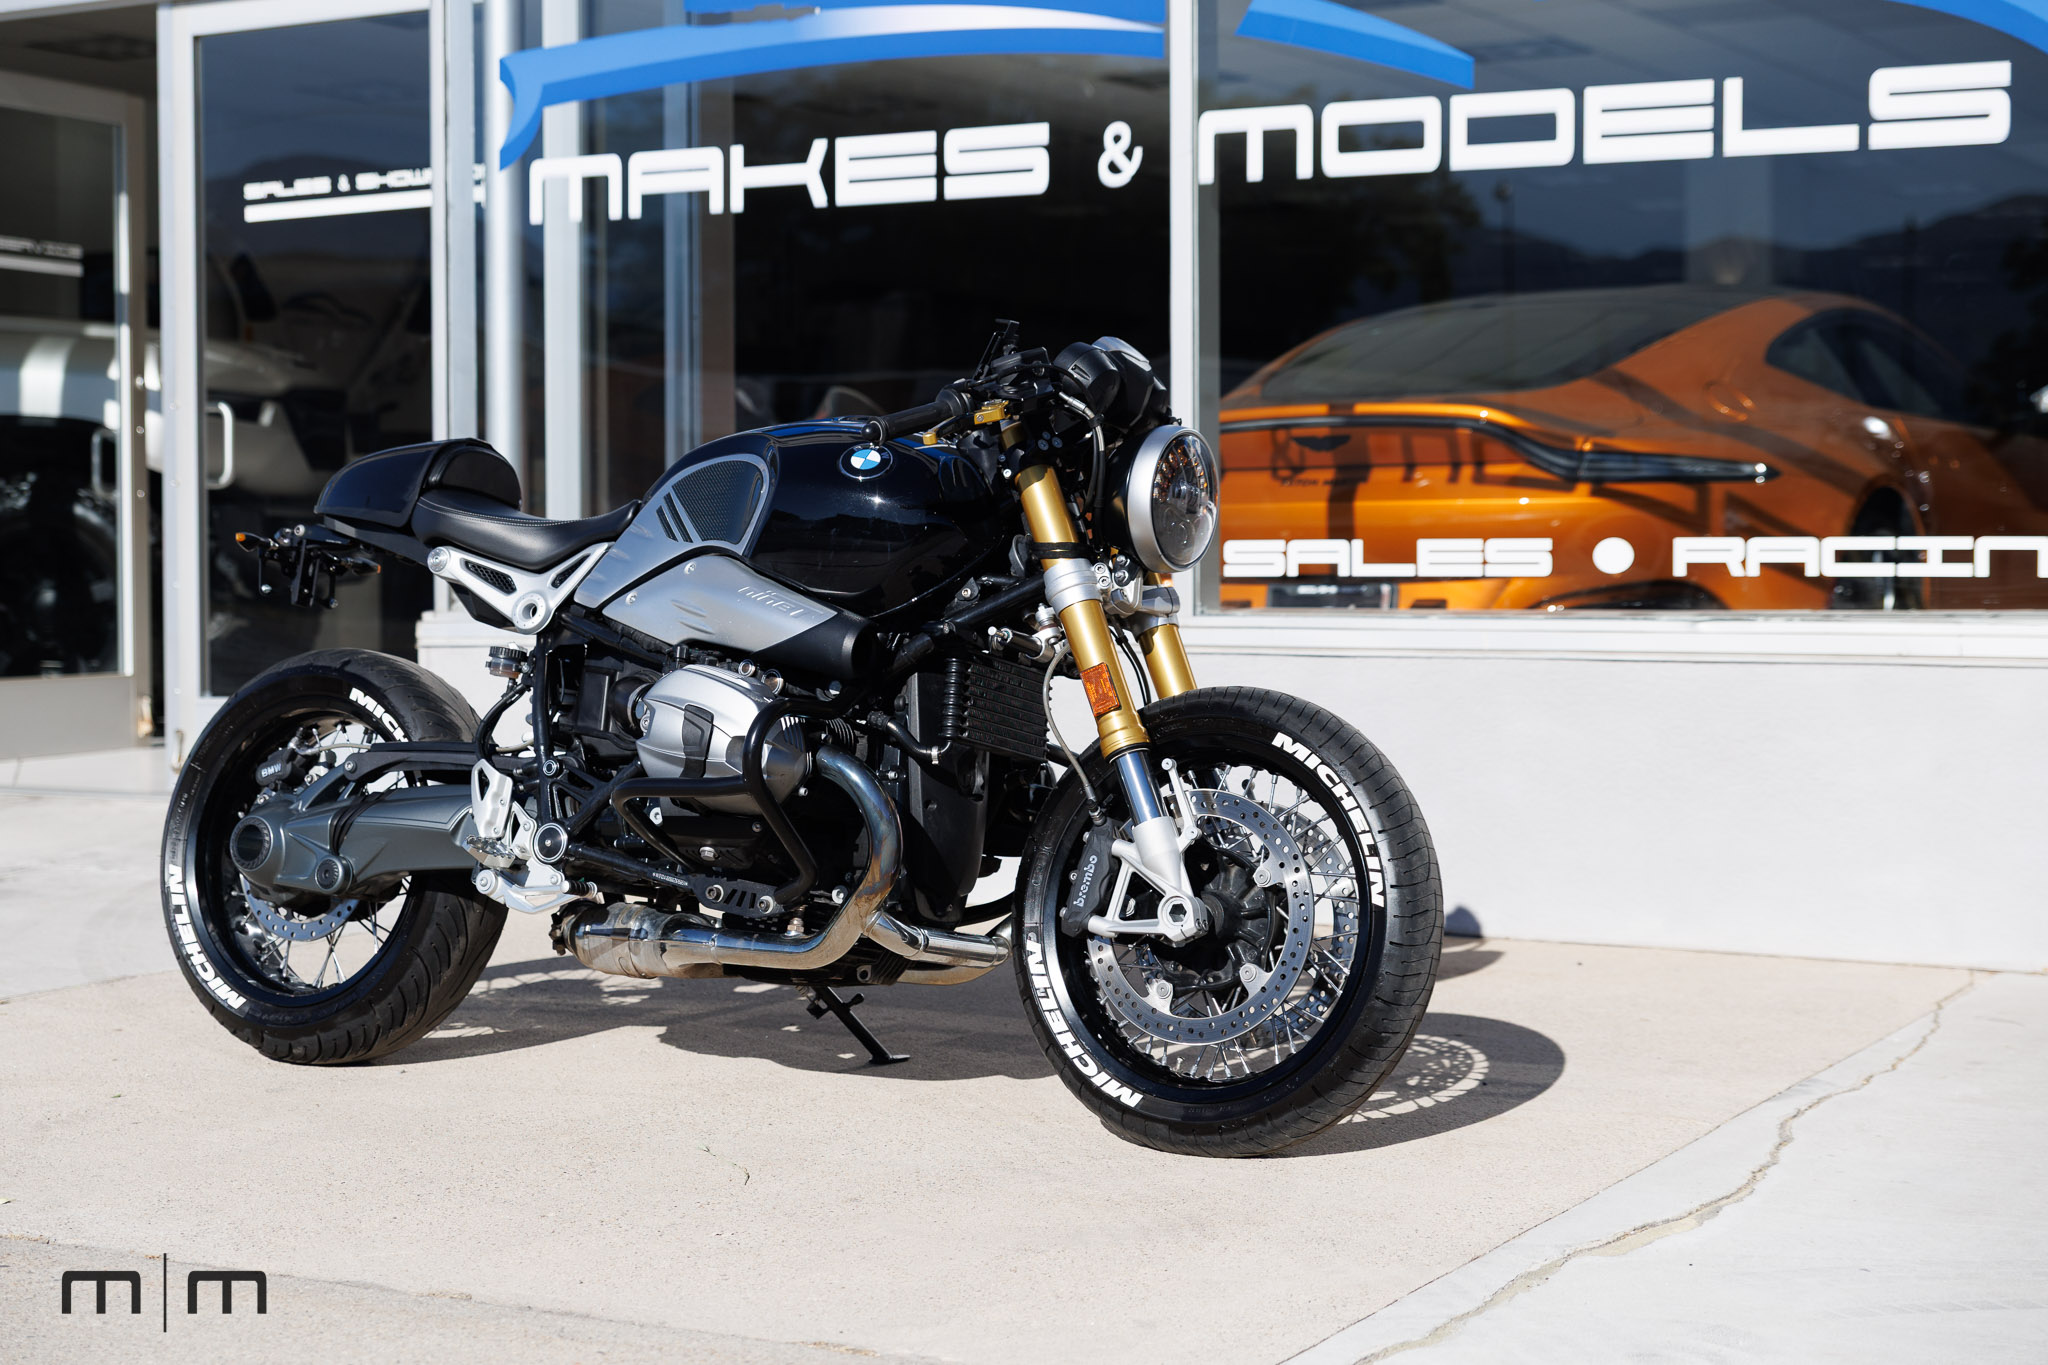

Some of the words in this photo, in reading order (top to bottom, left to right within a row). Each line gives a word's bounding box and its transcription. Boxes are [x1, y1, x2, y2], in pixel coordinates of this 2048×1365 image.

[528, 121, 1051, 226] MAKES
[1097, 120, 1144, 189] &
[1198, 59, 2012, 185] MODELS
[1222, 537, 1554, 579] SALES
[1671, 534, 2048, 579] RACIN
[261, 763, 282, 778] BMW
[1271, 731, 1386, 908] MICHELIN
[168, 863, 248, 1010] MICHELIN
[1072, 854, 1098, 908] brembo
[1025, 939, 1144, 1108] MICHELIN
